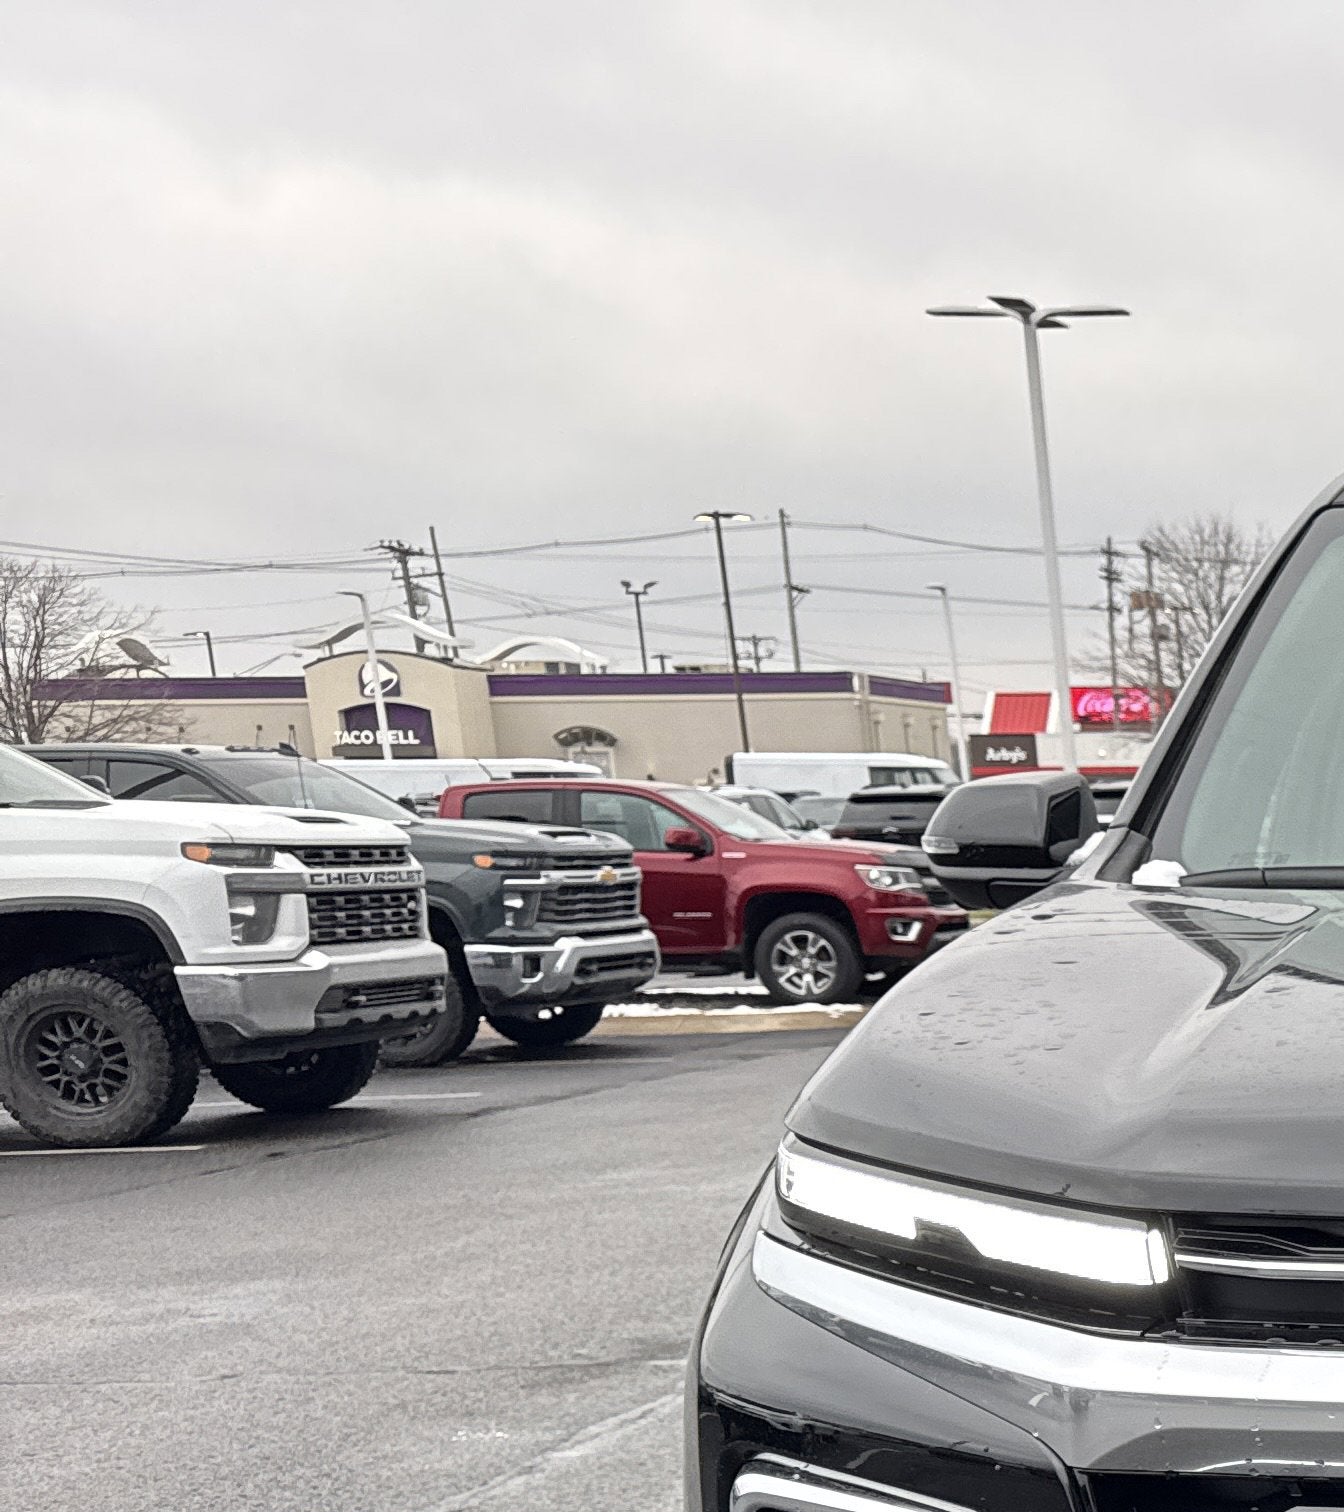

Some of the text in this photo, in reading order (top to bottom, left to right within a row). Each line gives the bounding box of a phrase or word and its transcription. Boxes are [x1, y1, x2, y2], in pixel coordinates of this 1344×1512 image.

[334, 730, 374, 745] TACO
[985, 746, 1028, 764] Arby's
[310, 870, 423, 886] CHEVROLET
